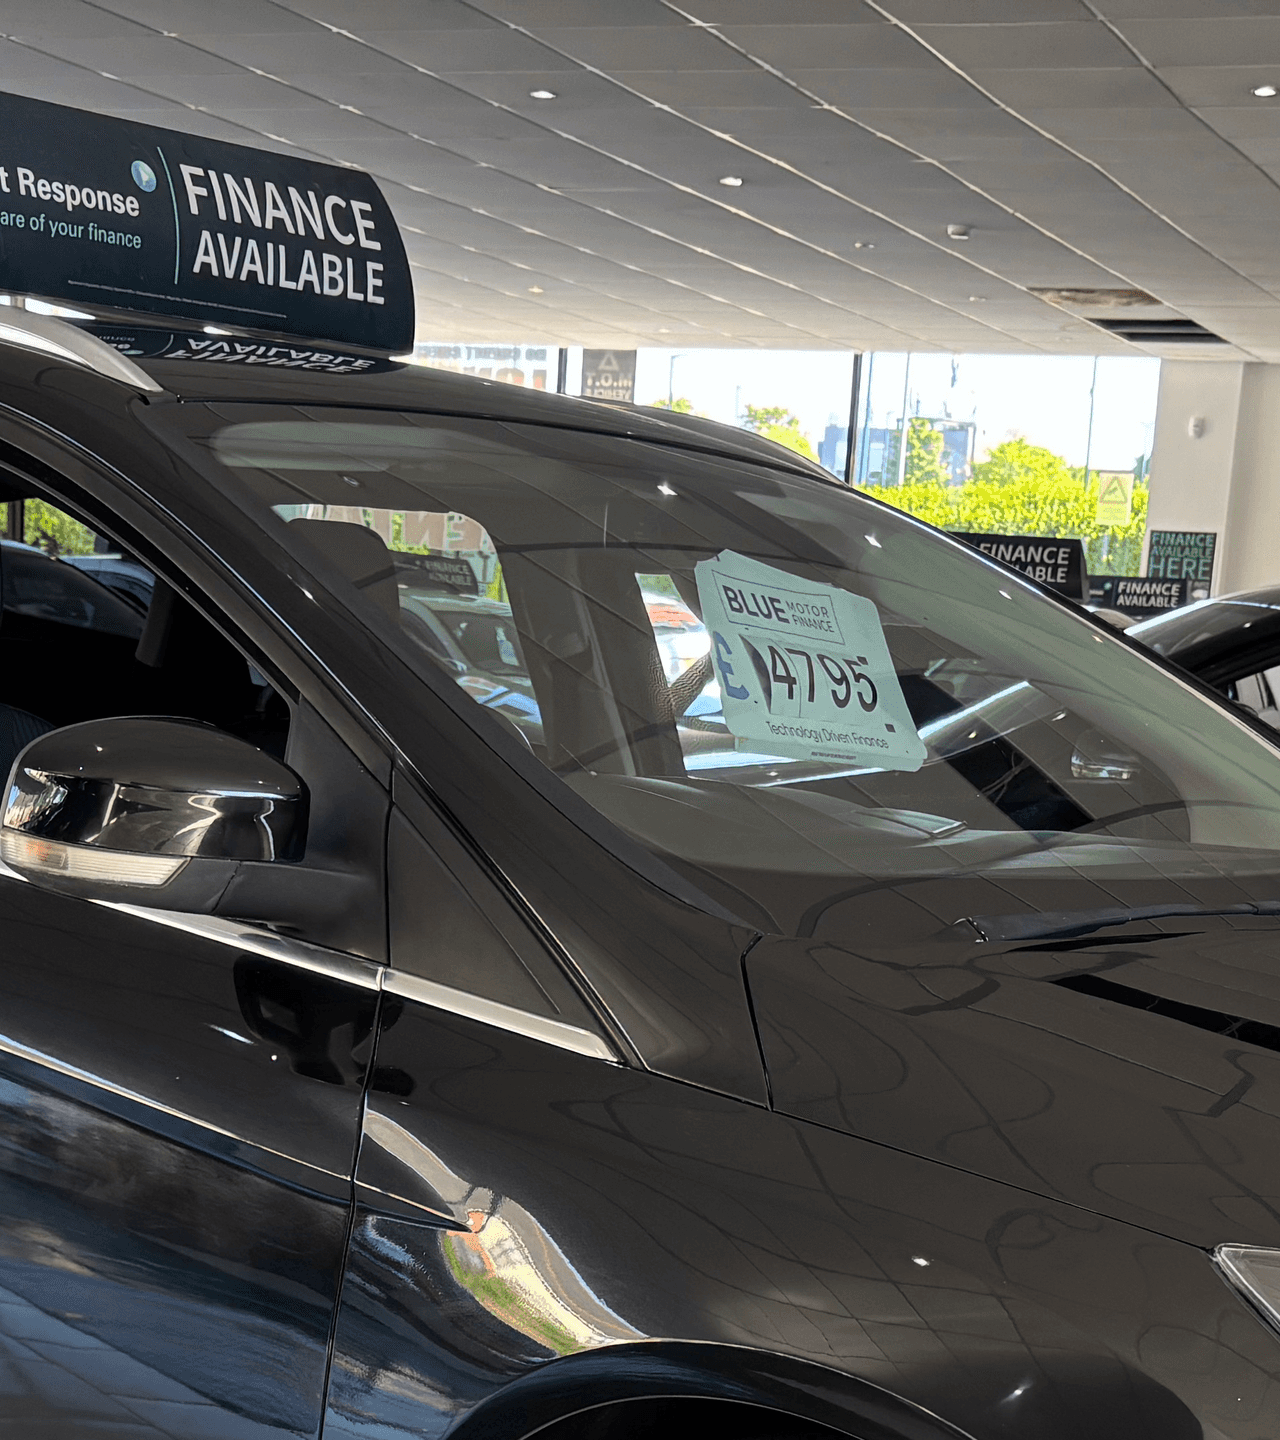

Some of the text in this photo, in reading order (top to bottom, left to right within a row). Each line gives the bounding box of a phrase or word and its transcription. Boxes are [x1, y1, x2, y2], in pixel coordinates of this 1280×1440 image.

[16, 166, 141, 218] Response
[178, 163, 383, 251] FINANCE
[29, 212, 46, 233] of
[49, 219, 85, 243] your
[87, 223, 142, 250] finance
[192, 230, 386, 305] AVAILABLE
[1151, 532, 1214, 547] FINANCE
[1151, 546, 1214, 560] AVAILABLE
[1148, 558, 1212, 581] HERE
[1116, 594, 1179, 608] AVAILABLE
[1117, 581, 1181, 596] FINANCE
[722, 584, 790, 624] BLUE
[786, 601, 829, 619] MOTOR
[792, 613, 835, 634] FINANCE
[713, 631, 878, 712] £ 4795
[766, 721, 889, 750] Technology Driven Finance
